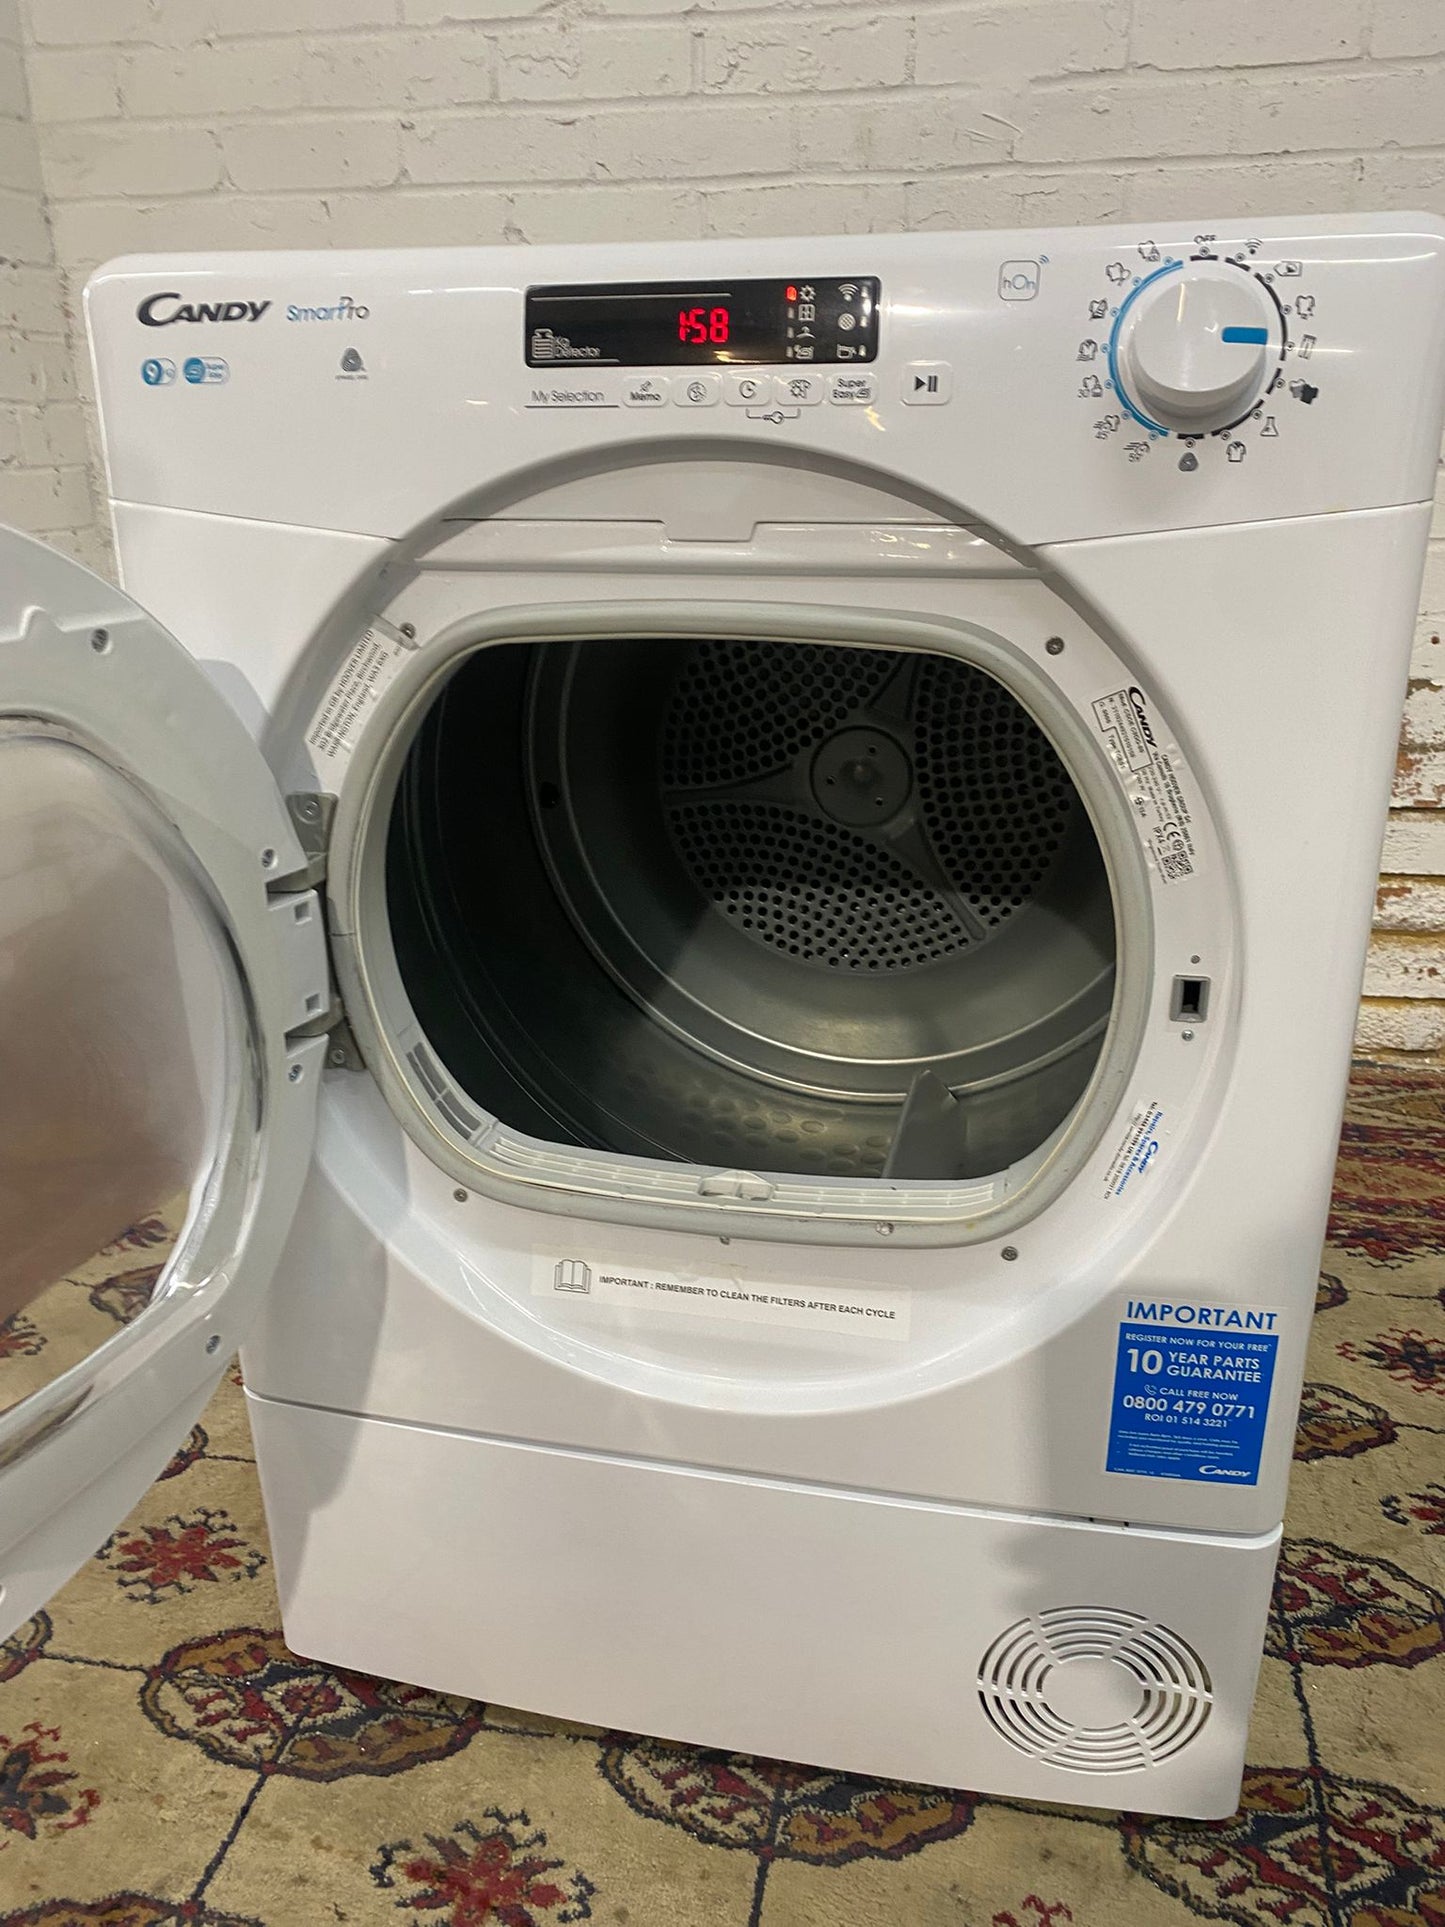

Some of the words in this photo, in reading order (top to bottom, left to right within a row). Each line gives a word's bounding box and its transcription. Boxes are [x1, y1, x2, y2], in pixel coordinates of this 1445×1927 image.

[1194, 235, 1216, 244] OFF
[837, 378, 866, 390] Super
[531, 390, 549, 404] My
[551, 390, 605, 402] Selection
[630, 391, 661, 401] Memo
[832, 389, 855, 400] Easy
[308, 714, 329, 744] Imported
[338, 657, 358, 687] HOOVER
[353, 629, 374, 658] LIMITED
[1152, 826, 1165, 843] IPX4
[1134, 1135, 1148, 1155] Spares
[1114, 1162, 1135, 1195] Accessories
[599, 1276, 649, 1288] IMPORTANT
[655, 1282, 704, 1295] REMEMBER
[706, 1289, 718, 1297] TO
[720, 1290, 749, 1301] CLEAN
[751, 1294, 769, 1303] THE
[770, 1296, 806, 1308] FILTERS
[807, 1301, 837, 1312] AFTER
[838, 1305, 863, 1315] EACH
[866, 1308, 896, 1319] CYCLE
[1127, 1301, 1277, 1330] IMPORTANT
[1125, 1333, 1167, 1344] REGISTER
[1170, 1337, 1194, 1346] NOW
[1197, 1339, 1216, 1347] FOR
[1218, 1341, 1244, 1350] YOUR
[1127, 1348, 1163, 1375] 10
[1168, 1351, 1208, 1365] YEAR
[1213, 1355, 1260, 1370] PARTS
[1167, 1365, 1262, 1383] GUARANTEE
[1160, 1387, 1184, 1397] CALL
[1187, 1389, 1210, 1399] FREE
[1212, 1391, 1239, 1401] NOW
[1123, 1394, 1168, 1412] 0800
[1173, 1399, 1207, 1414] 479
[1212, 1403, 1256, 1419] 0771
[1145, 1413, 1164, 1422] ROI
[1166, 1414, 1178, 1424] 01
[1181, 1416, 1200, 1426] 514
[1199, 1465, 1251, 1478] CANDY
